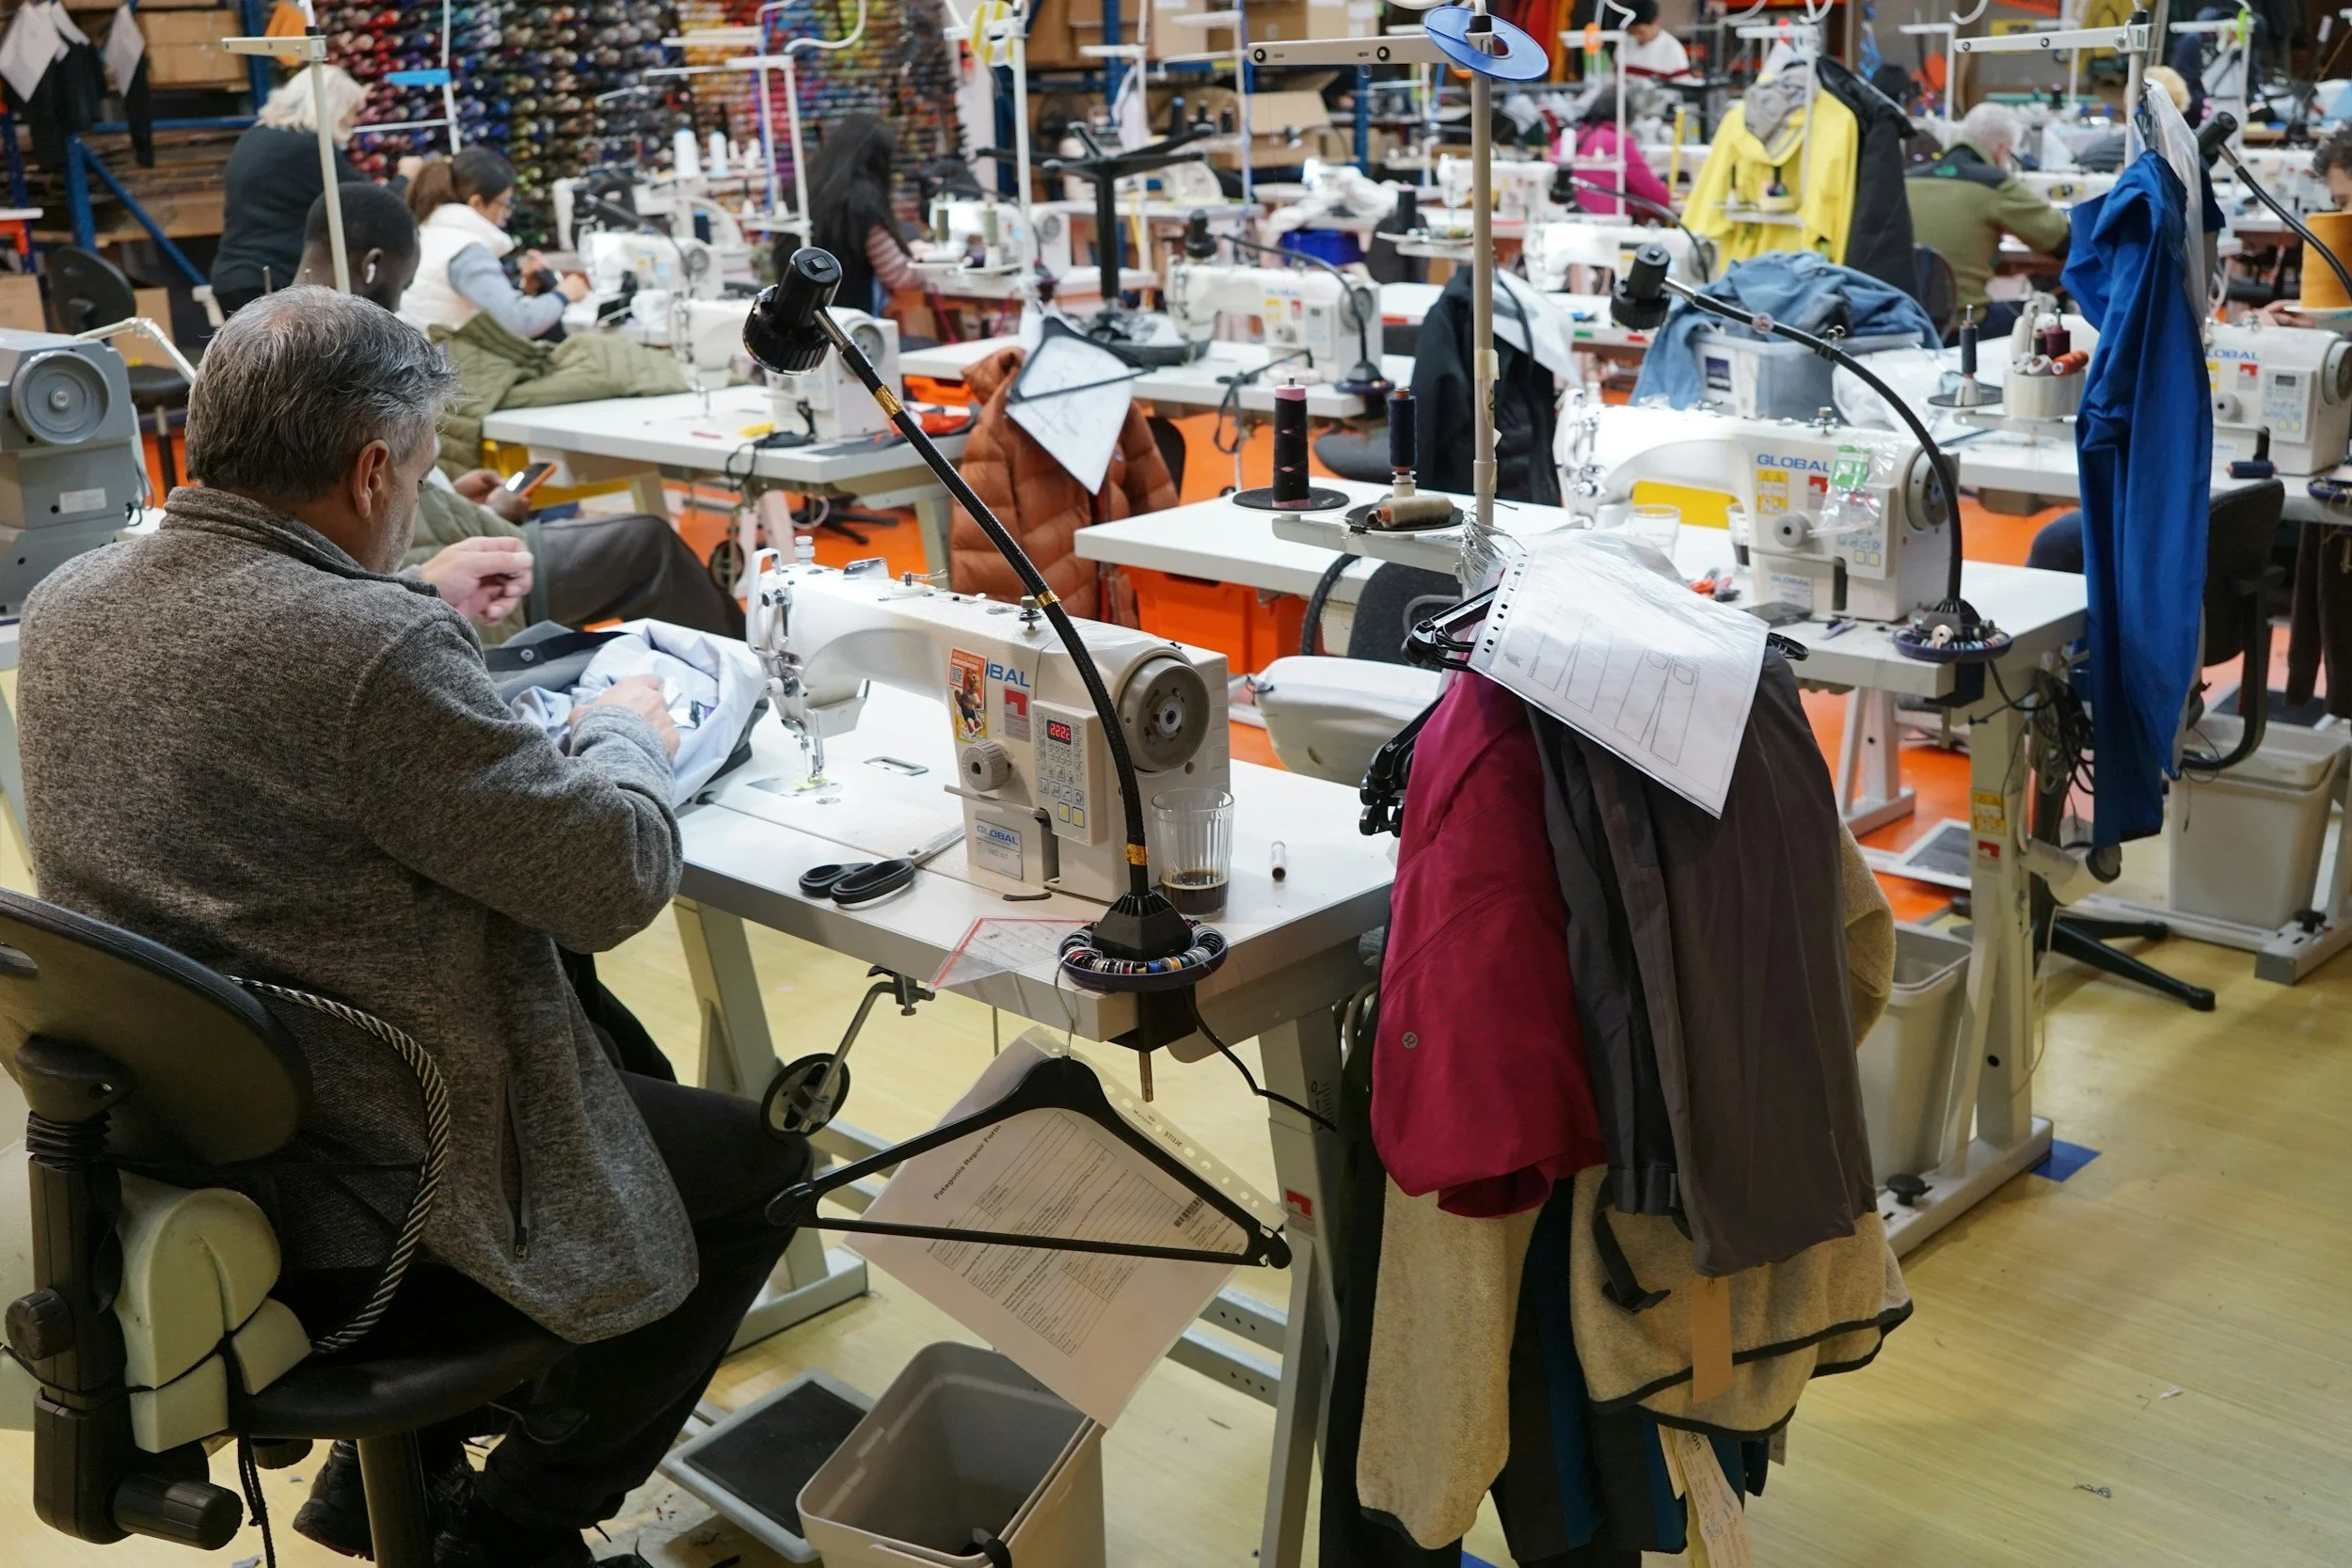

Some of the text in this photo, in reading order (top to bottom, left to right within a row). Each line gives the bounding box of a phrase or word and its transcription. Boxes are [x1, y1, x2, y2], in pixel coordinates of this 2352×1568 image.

[2204, 349, 2259, 361] LOBAL
[1756, 454, 1830, 473] GLOBAL
[985, 662, 1030, 688] BAL
[977, 825, 1019, 846] GLOBAL
[933, 1124, 1002, 1200] Patagonia Repair Form
